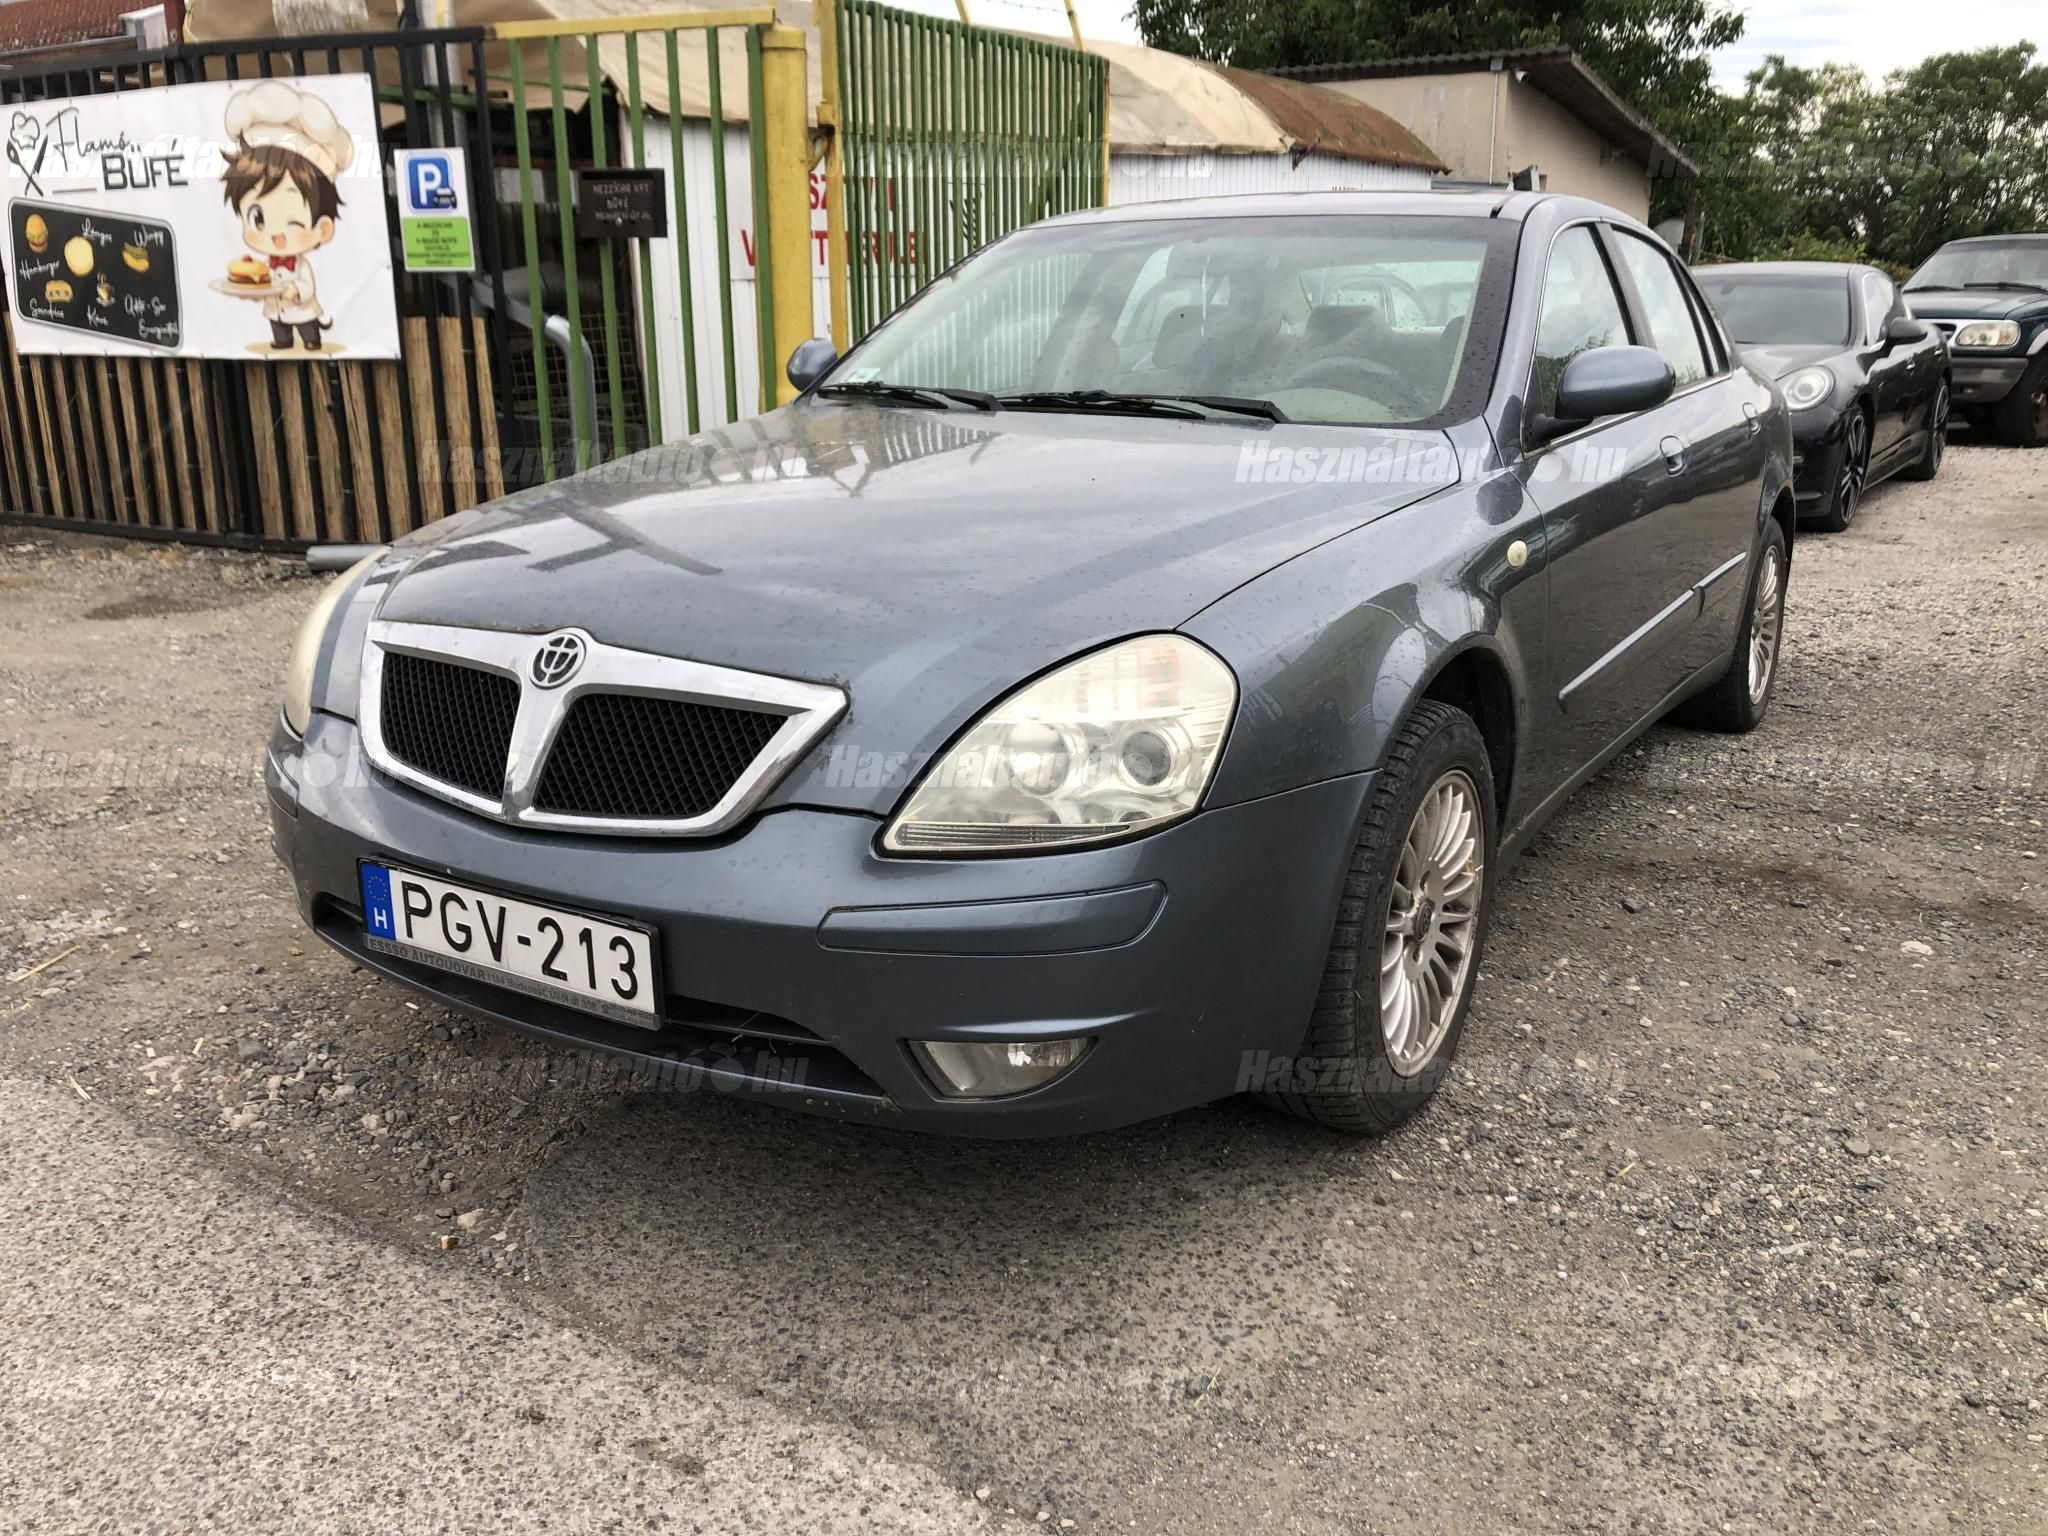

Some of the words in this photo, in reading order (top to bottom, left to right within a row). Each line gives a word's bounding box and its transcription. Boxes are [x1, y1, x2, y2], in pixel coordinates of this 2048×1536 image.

[101, 138, 189, 190] BÜFÉ
[417, 163, 442, 205] P
[373, 906, 389, 930] H
[401, 880, 638, 1000] PGV-213
